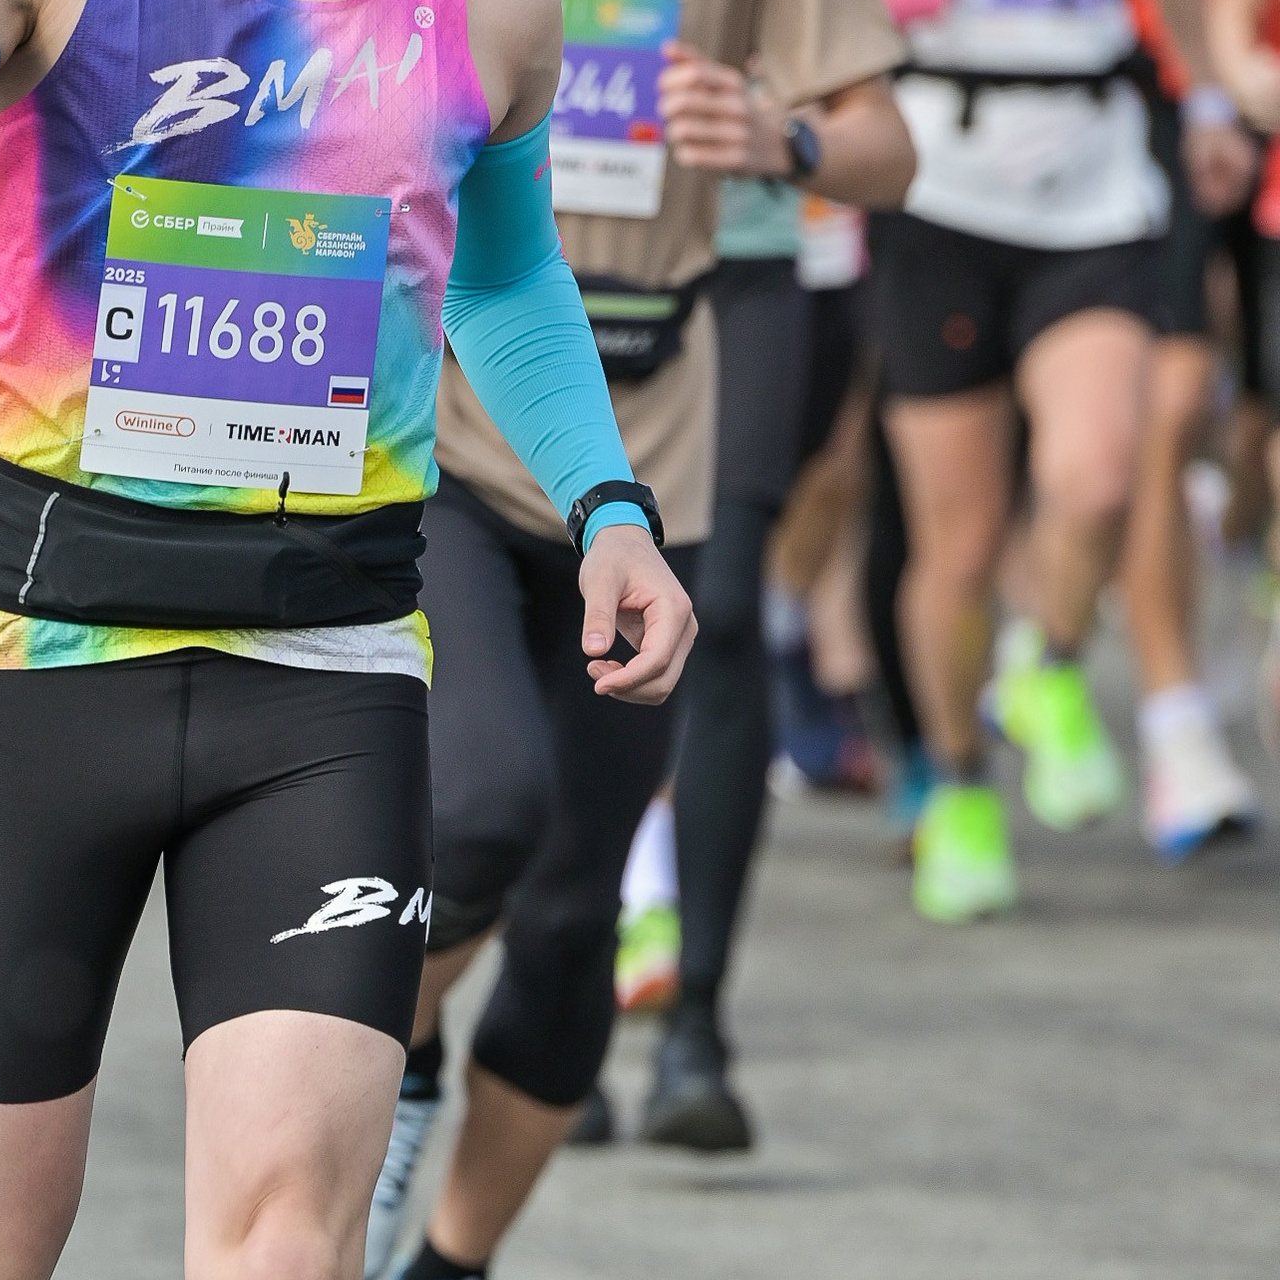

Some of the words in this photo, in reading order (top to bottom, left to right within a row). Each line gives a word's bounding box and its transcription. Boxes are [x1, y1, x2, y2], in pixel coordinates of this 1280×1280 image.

[153, 214, 195, 231] СБЕР
[202, 220, 235, 234] Прайм
[317, 231, 363, 243] СБЕРПРАЙМ
[315, 248, 355, 259] МАРАФОН
[316, 240, 366, 252] КАЗАНСКИЙ
[105, 267, 146, 284] 2025
[105, 306, 134, 340] C
[157, 292, 327, 366] 11688
[123, 414, 173, 432] Winline
[173, 463, 213, 475] Питание
[215, 467, 241, 477] после
[243, 469, 279, 481] финиша
